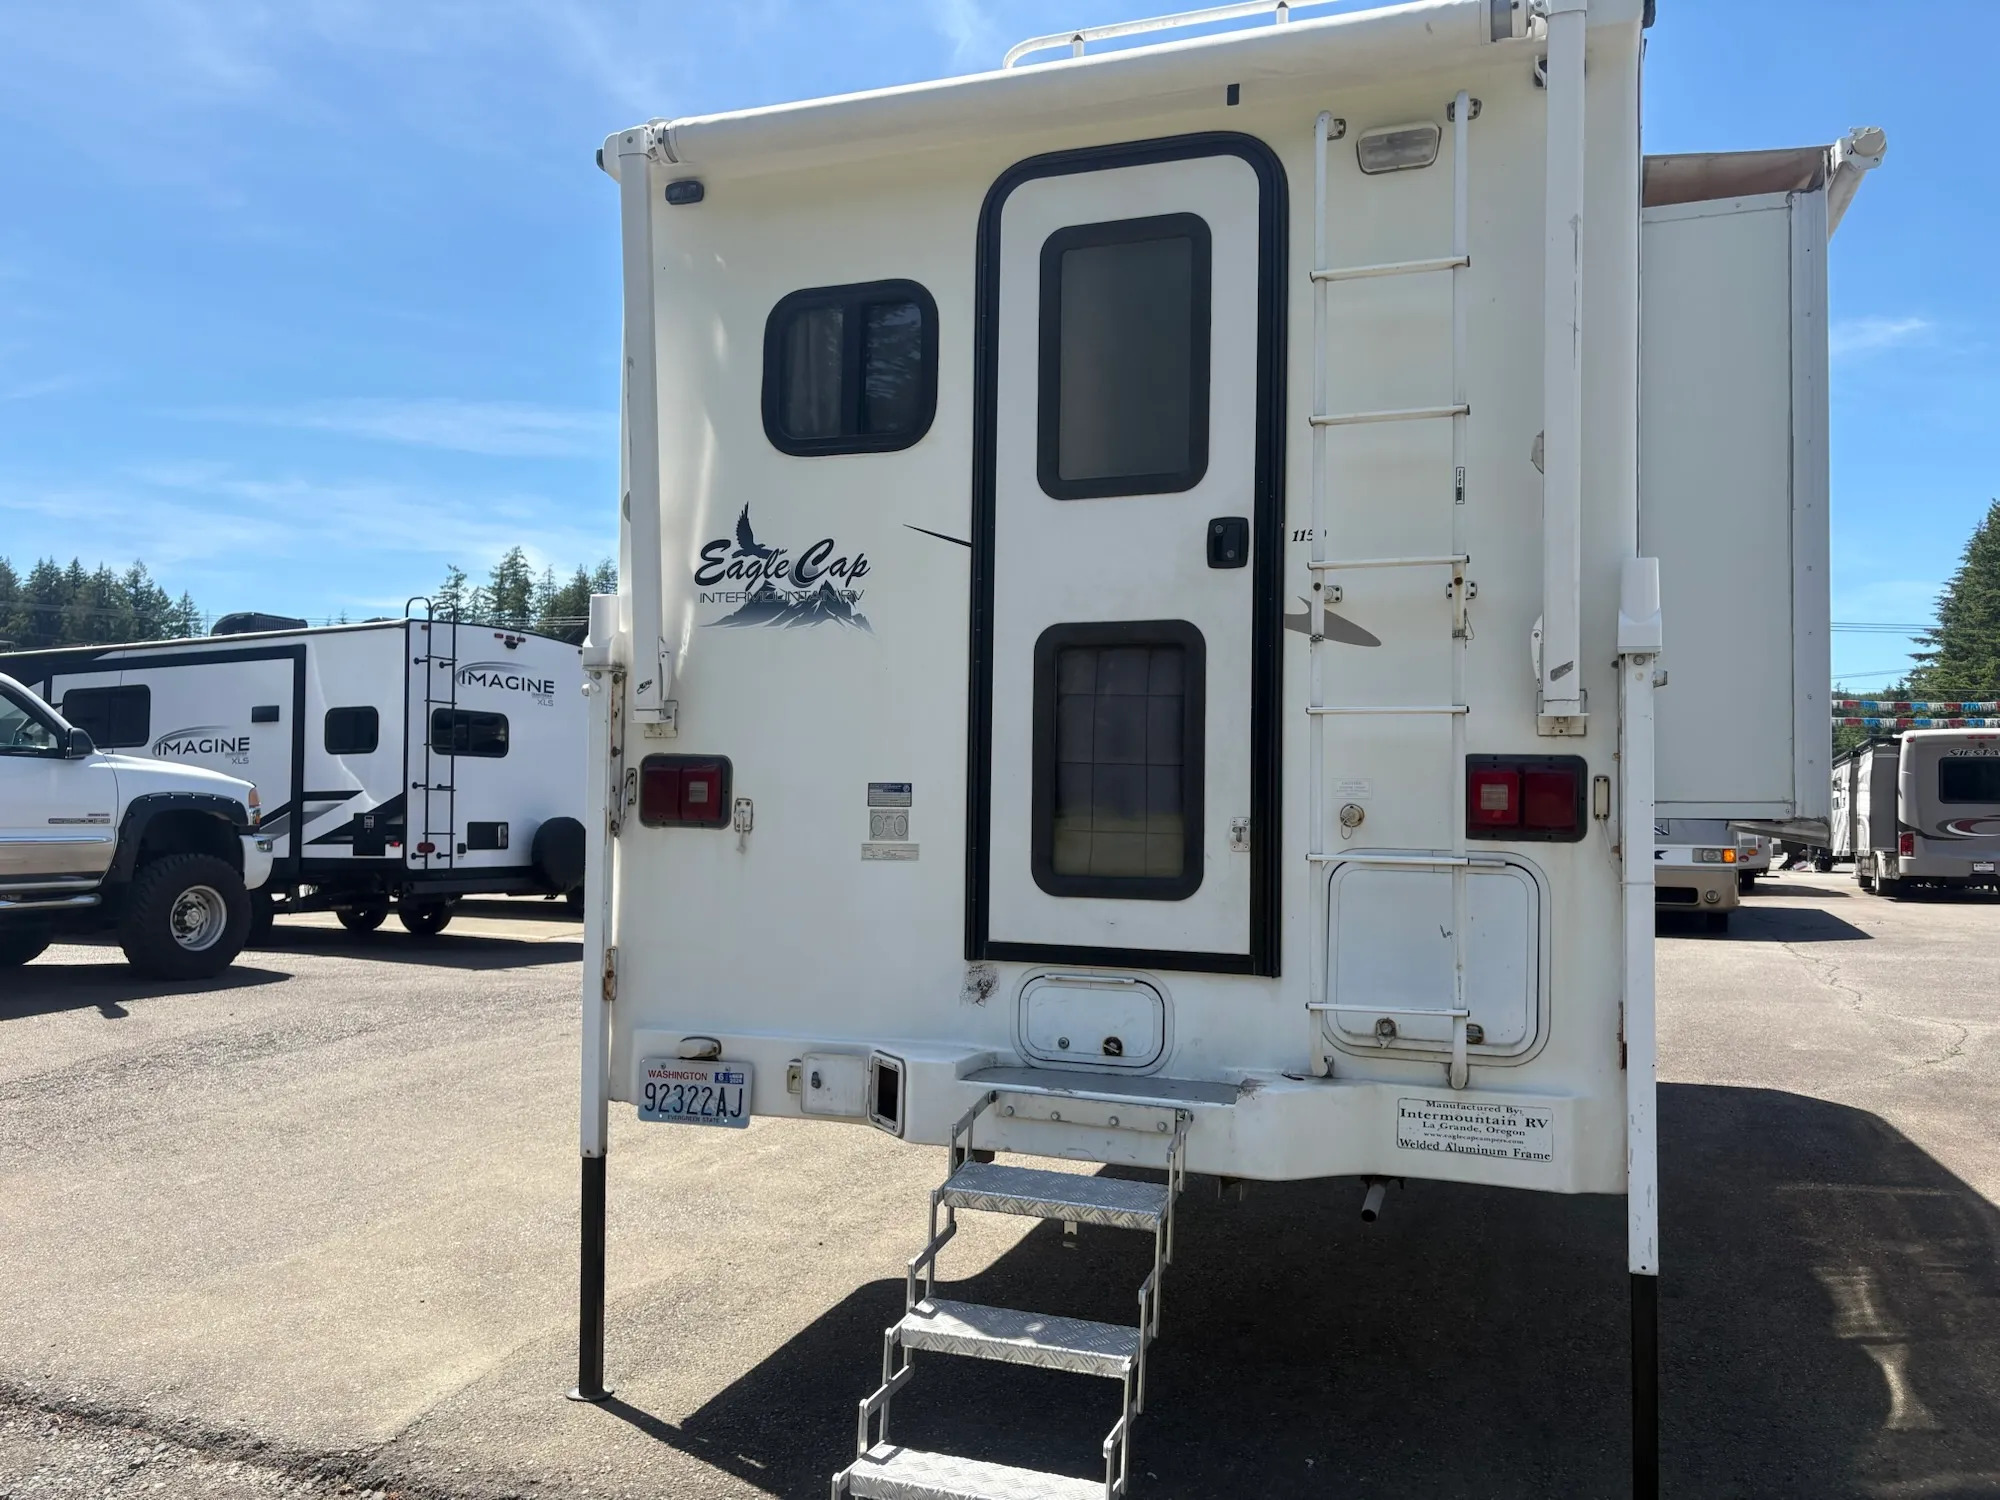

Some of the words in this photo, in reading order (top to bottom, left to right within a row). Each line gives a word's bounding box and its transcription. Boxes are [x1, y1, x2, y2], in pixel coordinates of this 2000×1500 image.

[1292, 529, 1327, 542] 115
[694, 538, 791, 593] Eagle
[794, 537, 871, 588] Cap
[699, 589, 839, 604] INTERMOUNTAIN
[461, 669, 555, 695] IMAGINE
[537, 699, 554, 707] XLS
[157, 736, 250, 756] IMAGINE
[1949, 748, 1999, 757] SIESTA
[231, 756, 250, 765] XLS
[647, 1069, 708, 1081] WASHINGTON
[644, 1082, 743, 1118] 92322AJ
[1426, 1100, 1501, 1113] Manufactured
[1400, 1108, 1517, 1127] Intermountain
[1525, 1117, 1549, 1129] RV
[1422, 1121, 1435, 1129] La
[1438, 1122, 1482, 1134] Grande,
[1486, 1126, 1526, 1138] Oregon
[1400, 1138, 1440, 1151] Welded
[1445, 1142, 1508, 1157] Aluminum
[1513, 1148, 1551, 1161] Frame
